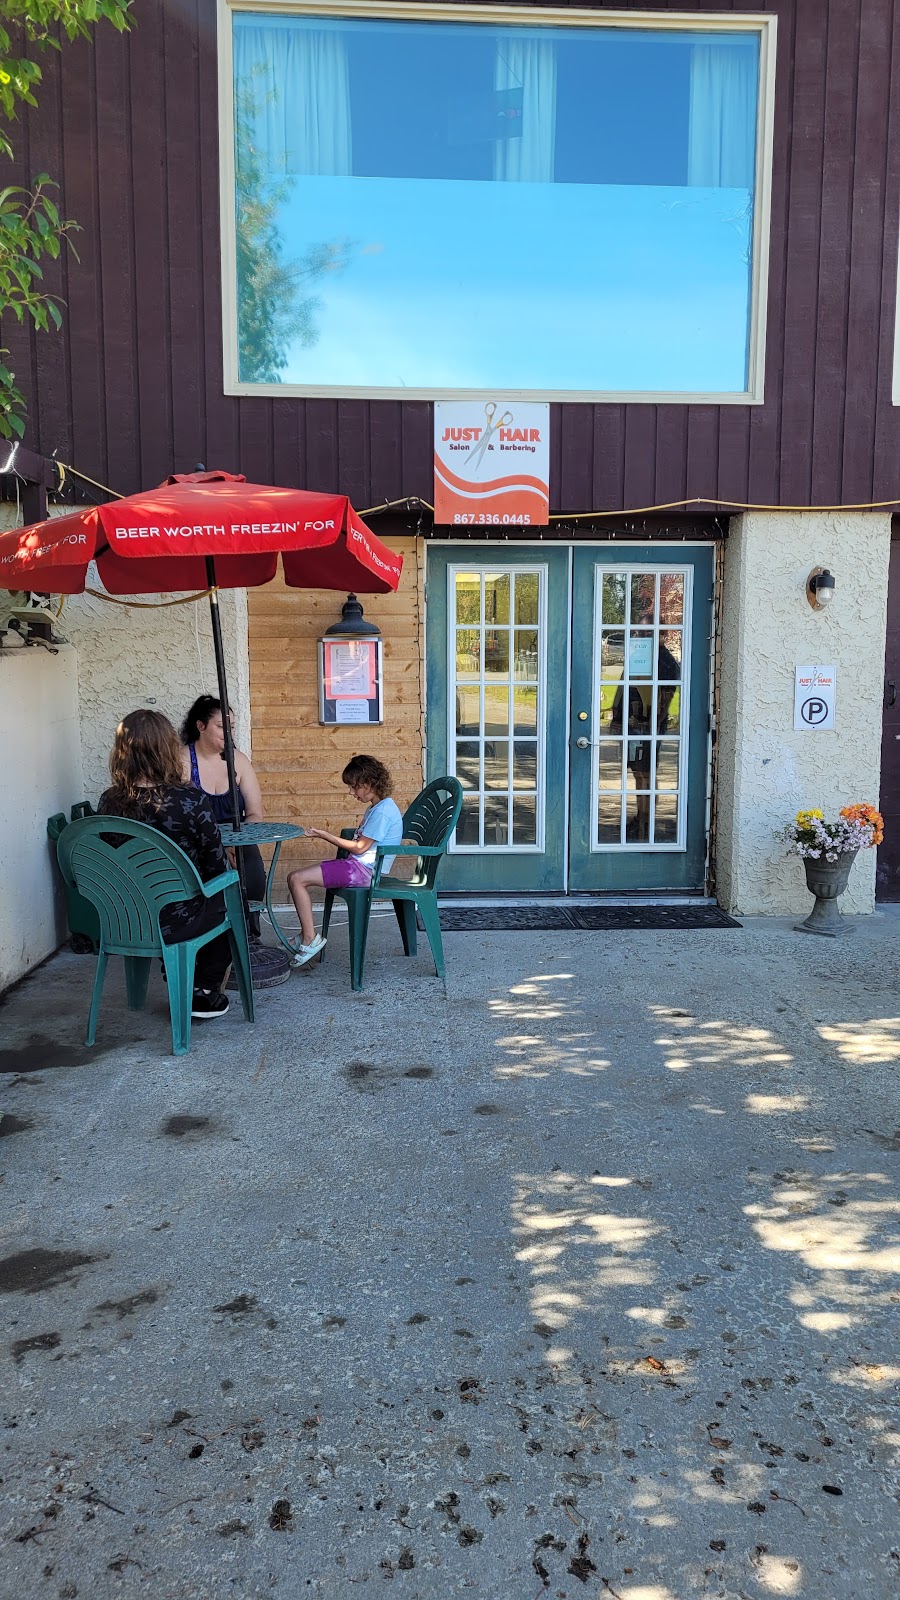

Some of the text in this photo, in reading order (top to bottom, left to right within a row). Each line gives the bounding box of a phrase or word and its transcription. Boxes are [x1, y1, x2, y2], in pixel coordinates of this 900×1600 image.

[442, 428, 541, 442] JUST HAIR
[500, 444, 536, 453] Barbering
[454, 514, 531, 524] 867.336.0445
[115, 520, 335, 539] BEER WORTH FREEZIN' FOR
[63, 534, 87, 545] FOR
[808, 702, 824, 721] P
